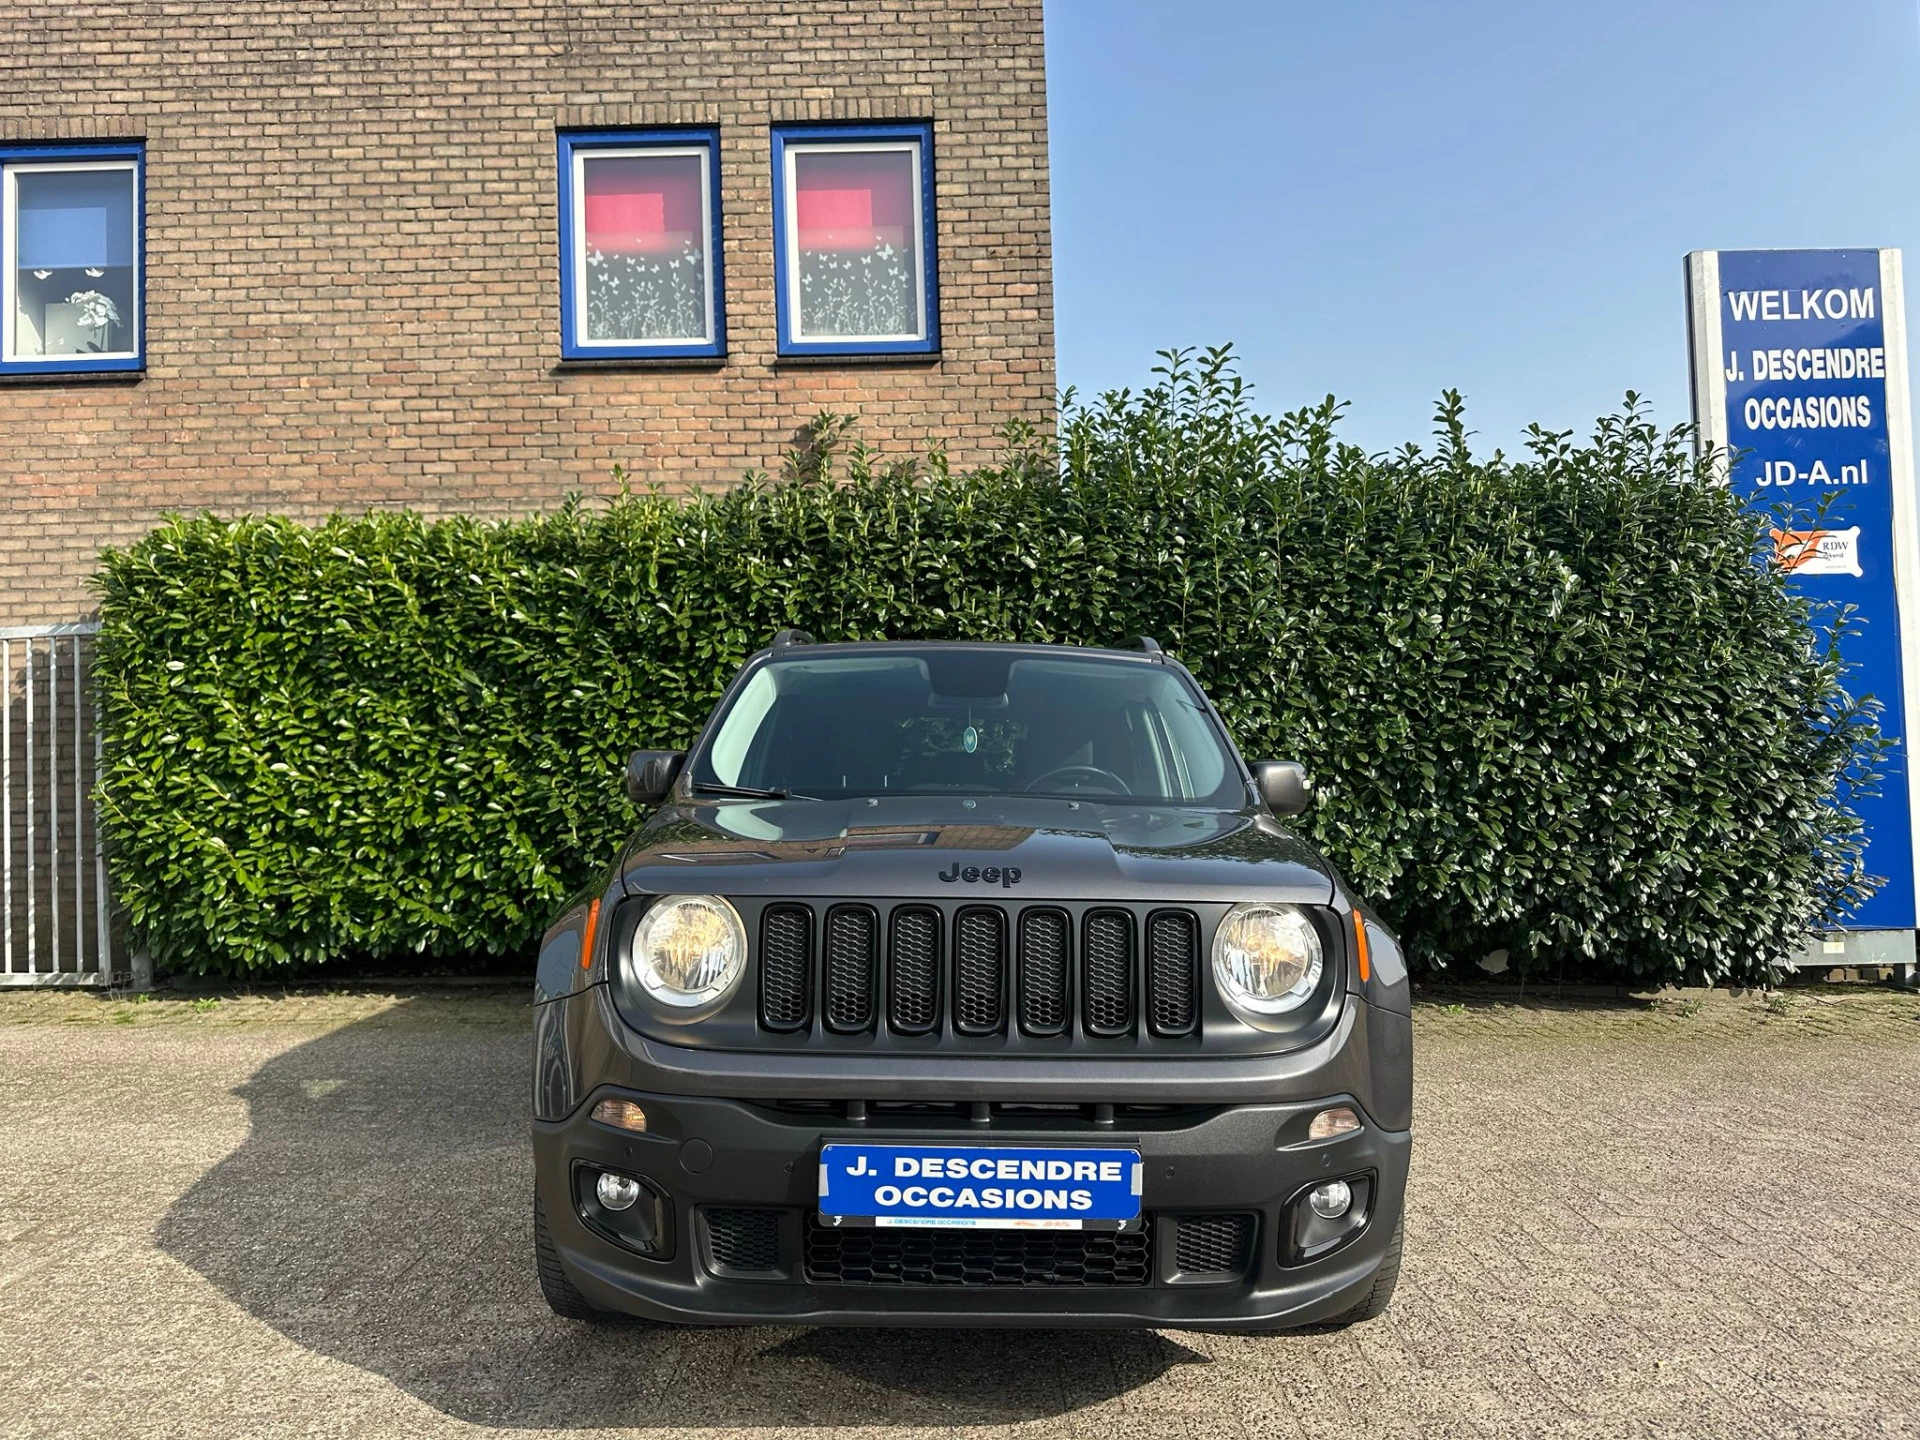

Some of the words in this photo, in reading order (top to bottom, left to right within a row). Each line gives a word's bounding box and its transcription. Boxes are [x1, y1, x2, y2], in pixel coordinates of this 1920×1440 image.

[1727, 288, 1875, 321] WELKOM
[1725, 351, 1744, 382] J.
[1752, 347, 1886, 381] DESCENDRE
[1744, 395, 1871, 430] OCCASIONS
[1755, 459, 1868, 487] JD-A.nl
[1822, 541, 1849, 551] RDW
[938, 862, 1022, 888] Jeep
[846, 1156, 877, 1176] J.
[894, 1157, 1122, 1181] DESCENDRE
[874, 1185, 1093, 1210] OCCASIONS
